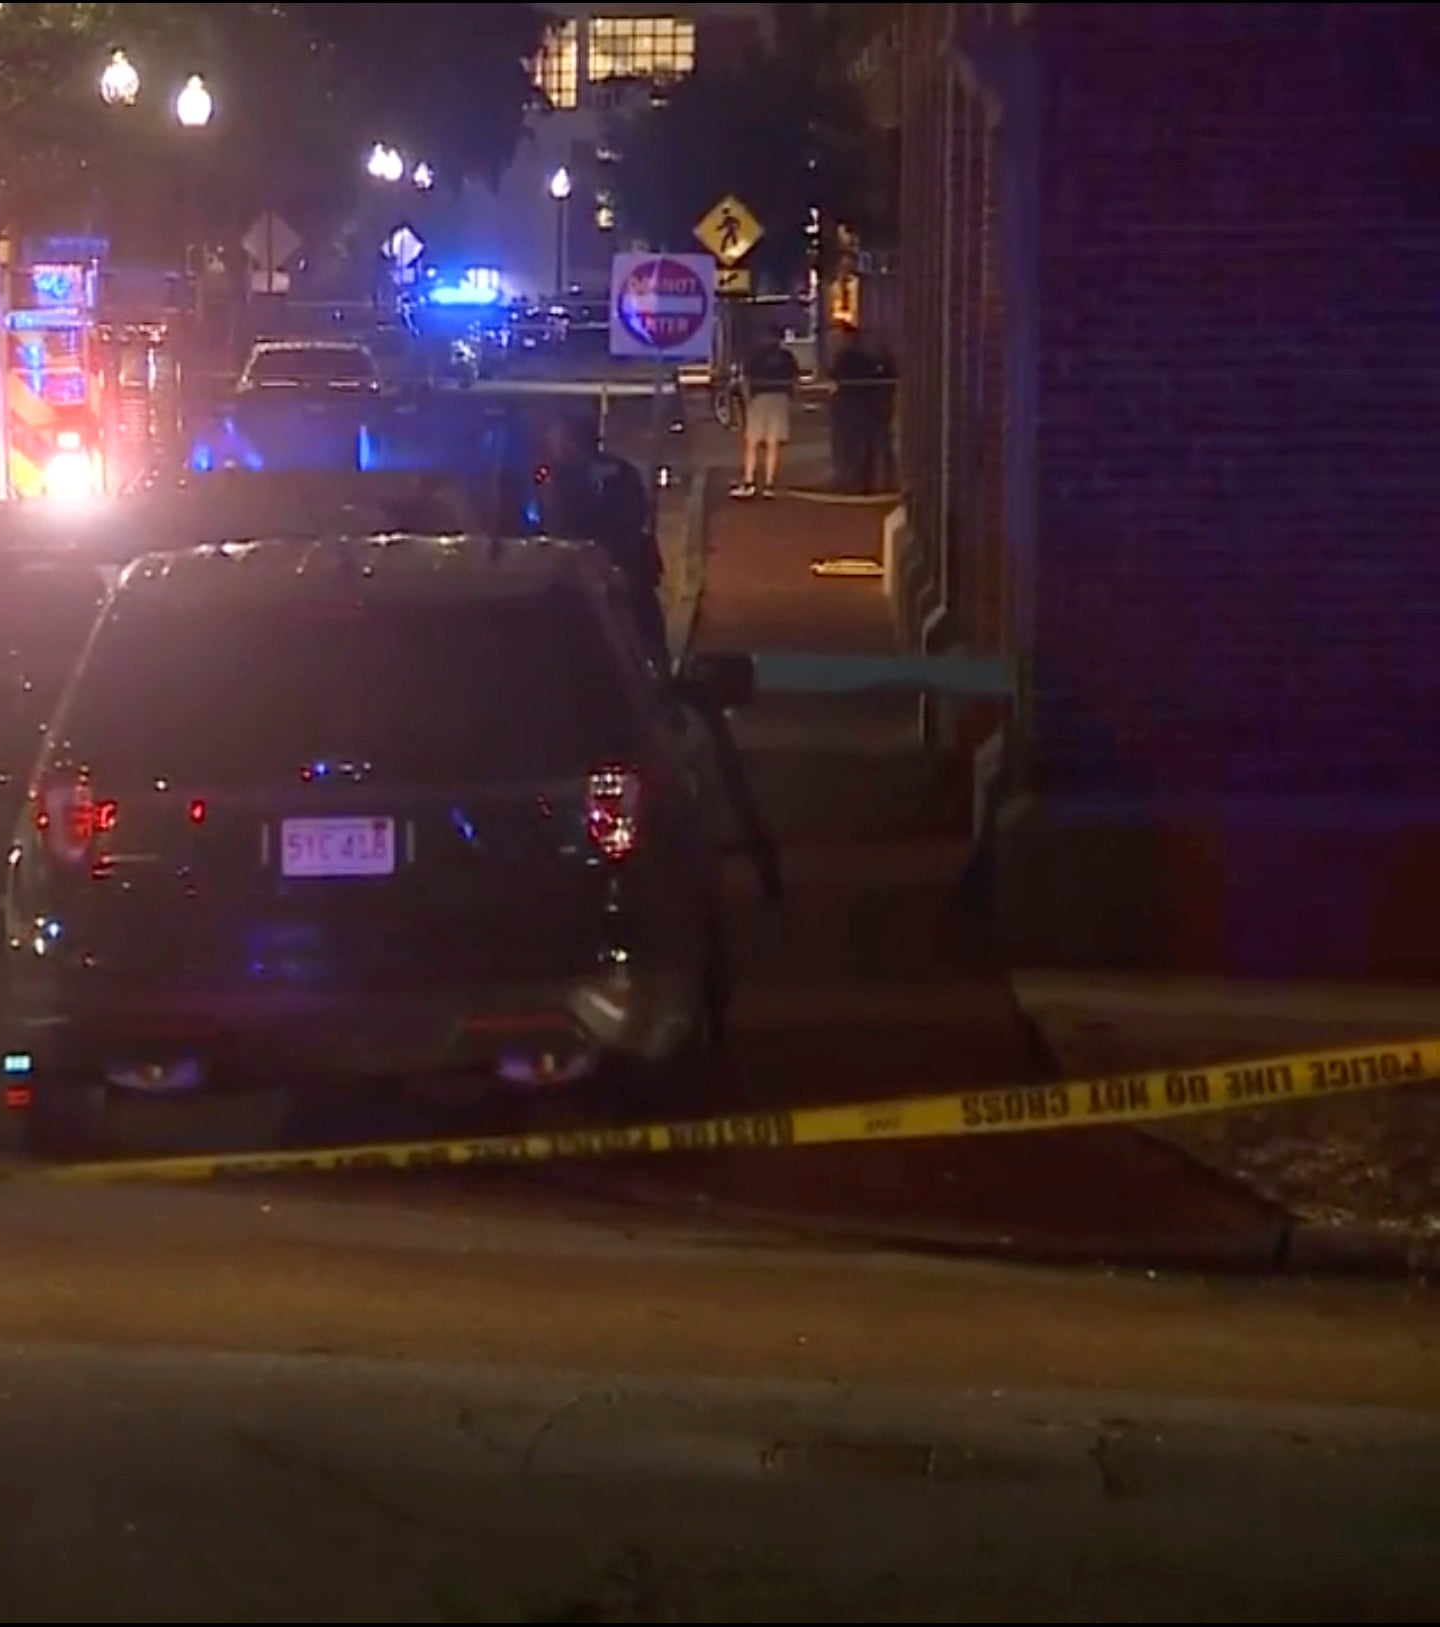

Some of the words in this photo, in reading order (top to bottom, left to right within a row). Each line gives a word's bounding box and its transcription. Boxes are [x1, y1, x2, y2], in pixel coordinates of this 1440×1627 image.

[662, 277, 697, 296] NOT
[637, 317, 689, 334] NTER
[1223, 1064, 1295, 1099] LINE
[1308, 1050, 1422, 1090] POLICE
[961, 1086, 1070, 1127] CROSS
[1087, 1078, 1151, 1115] NOT
[1164, 1074, 1210, 1106] DO
